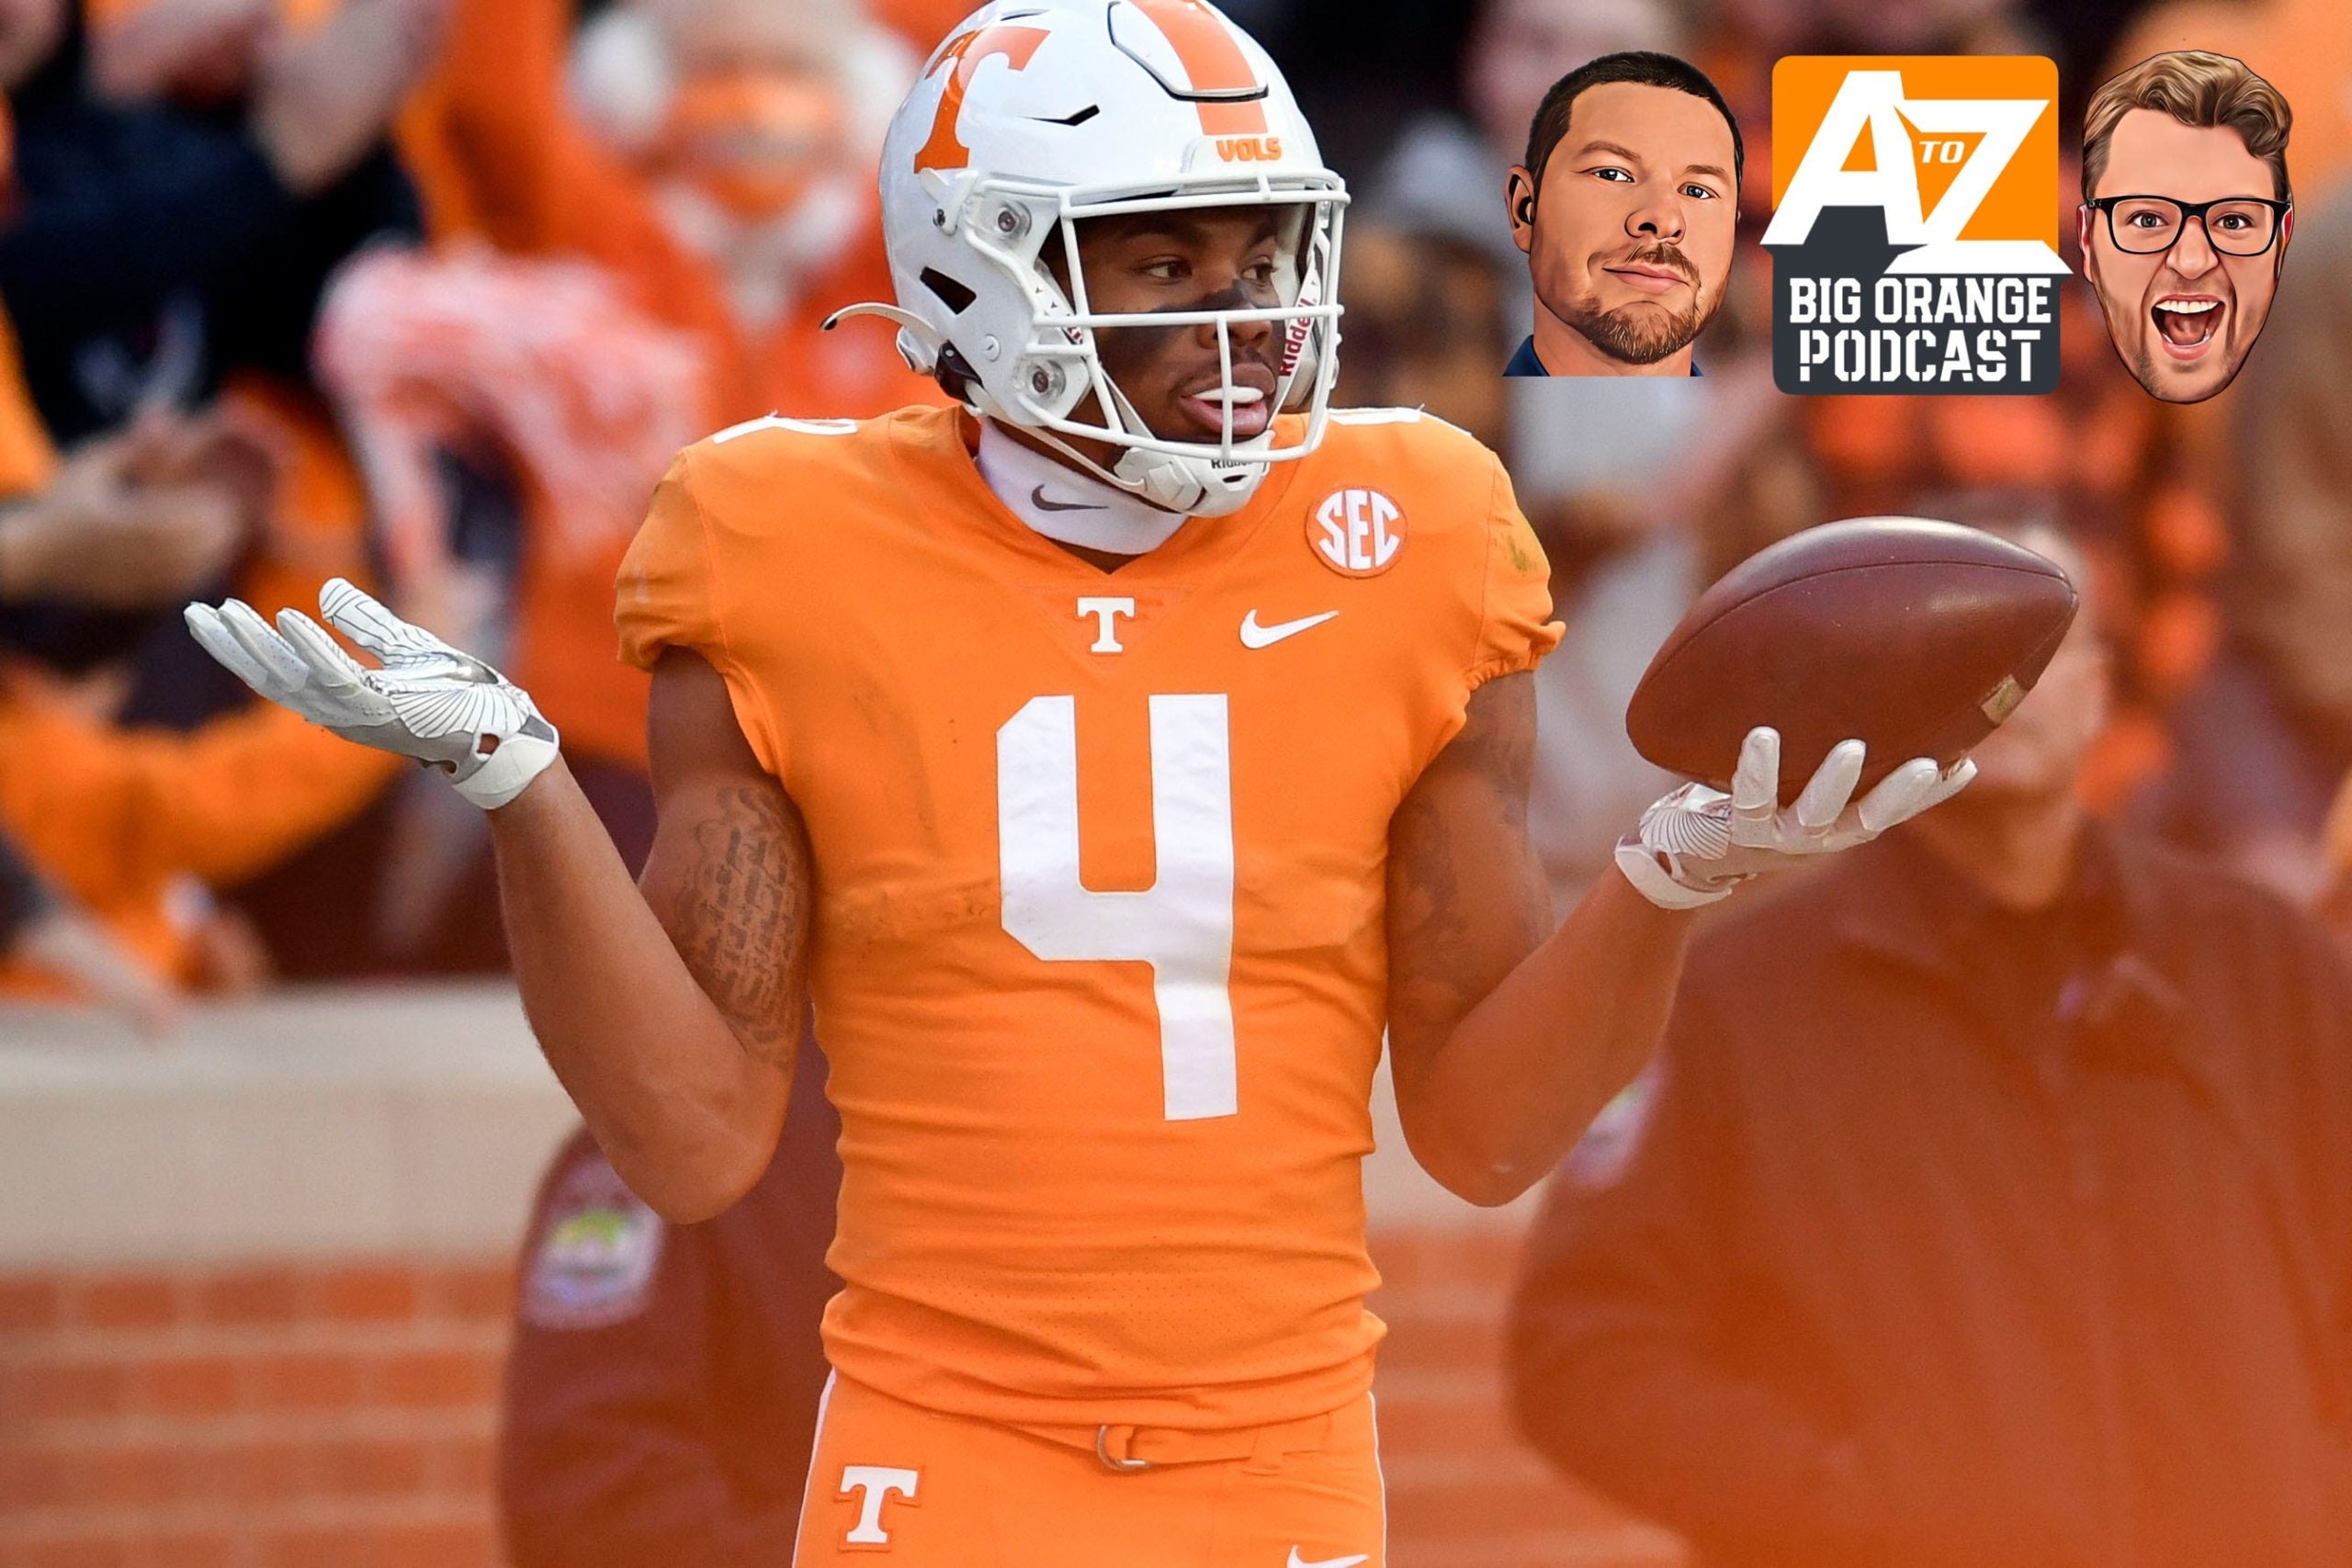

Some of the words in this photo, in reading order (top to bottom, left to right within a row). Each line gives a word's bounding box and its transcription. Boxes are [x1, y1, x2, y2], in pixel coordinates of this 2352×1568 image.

[914, 27, 1051, 175] T
[1216, 138, 1282, 163] VOLS
[1315, 488, 1401, 570] SEC
[1077, 596, 1136, 653] T
[996, 693, 1238, 1122] 4
[839, 1465, 919, 1543] T
